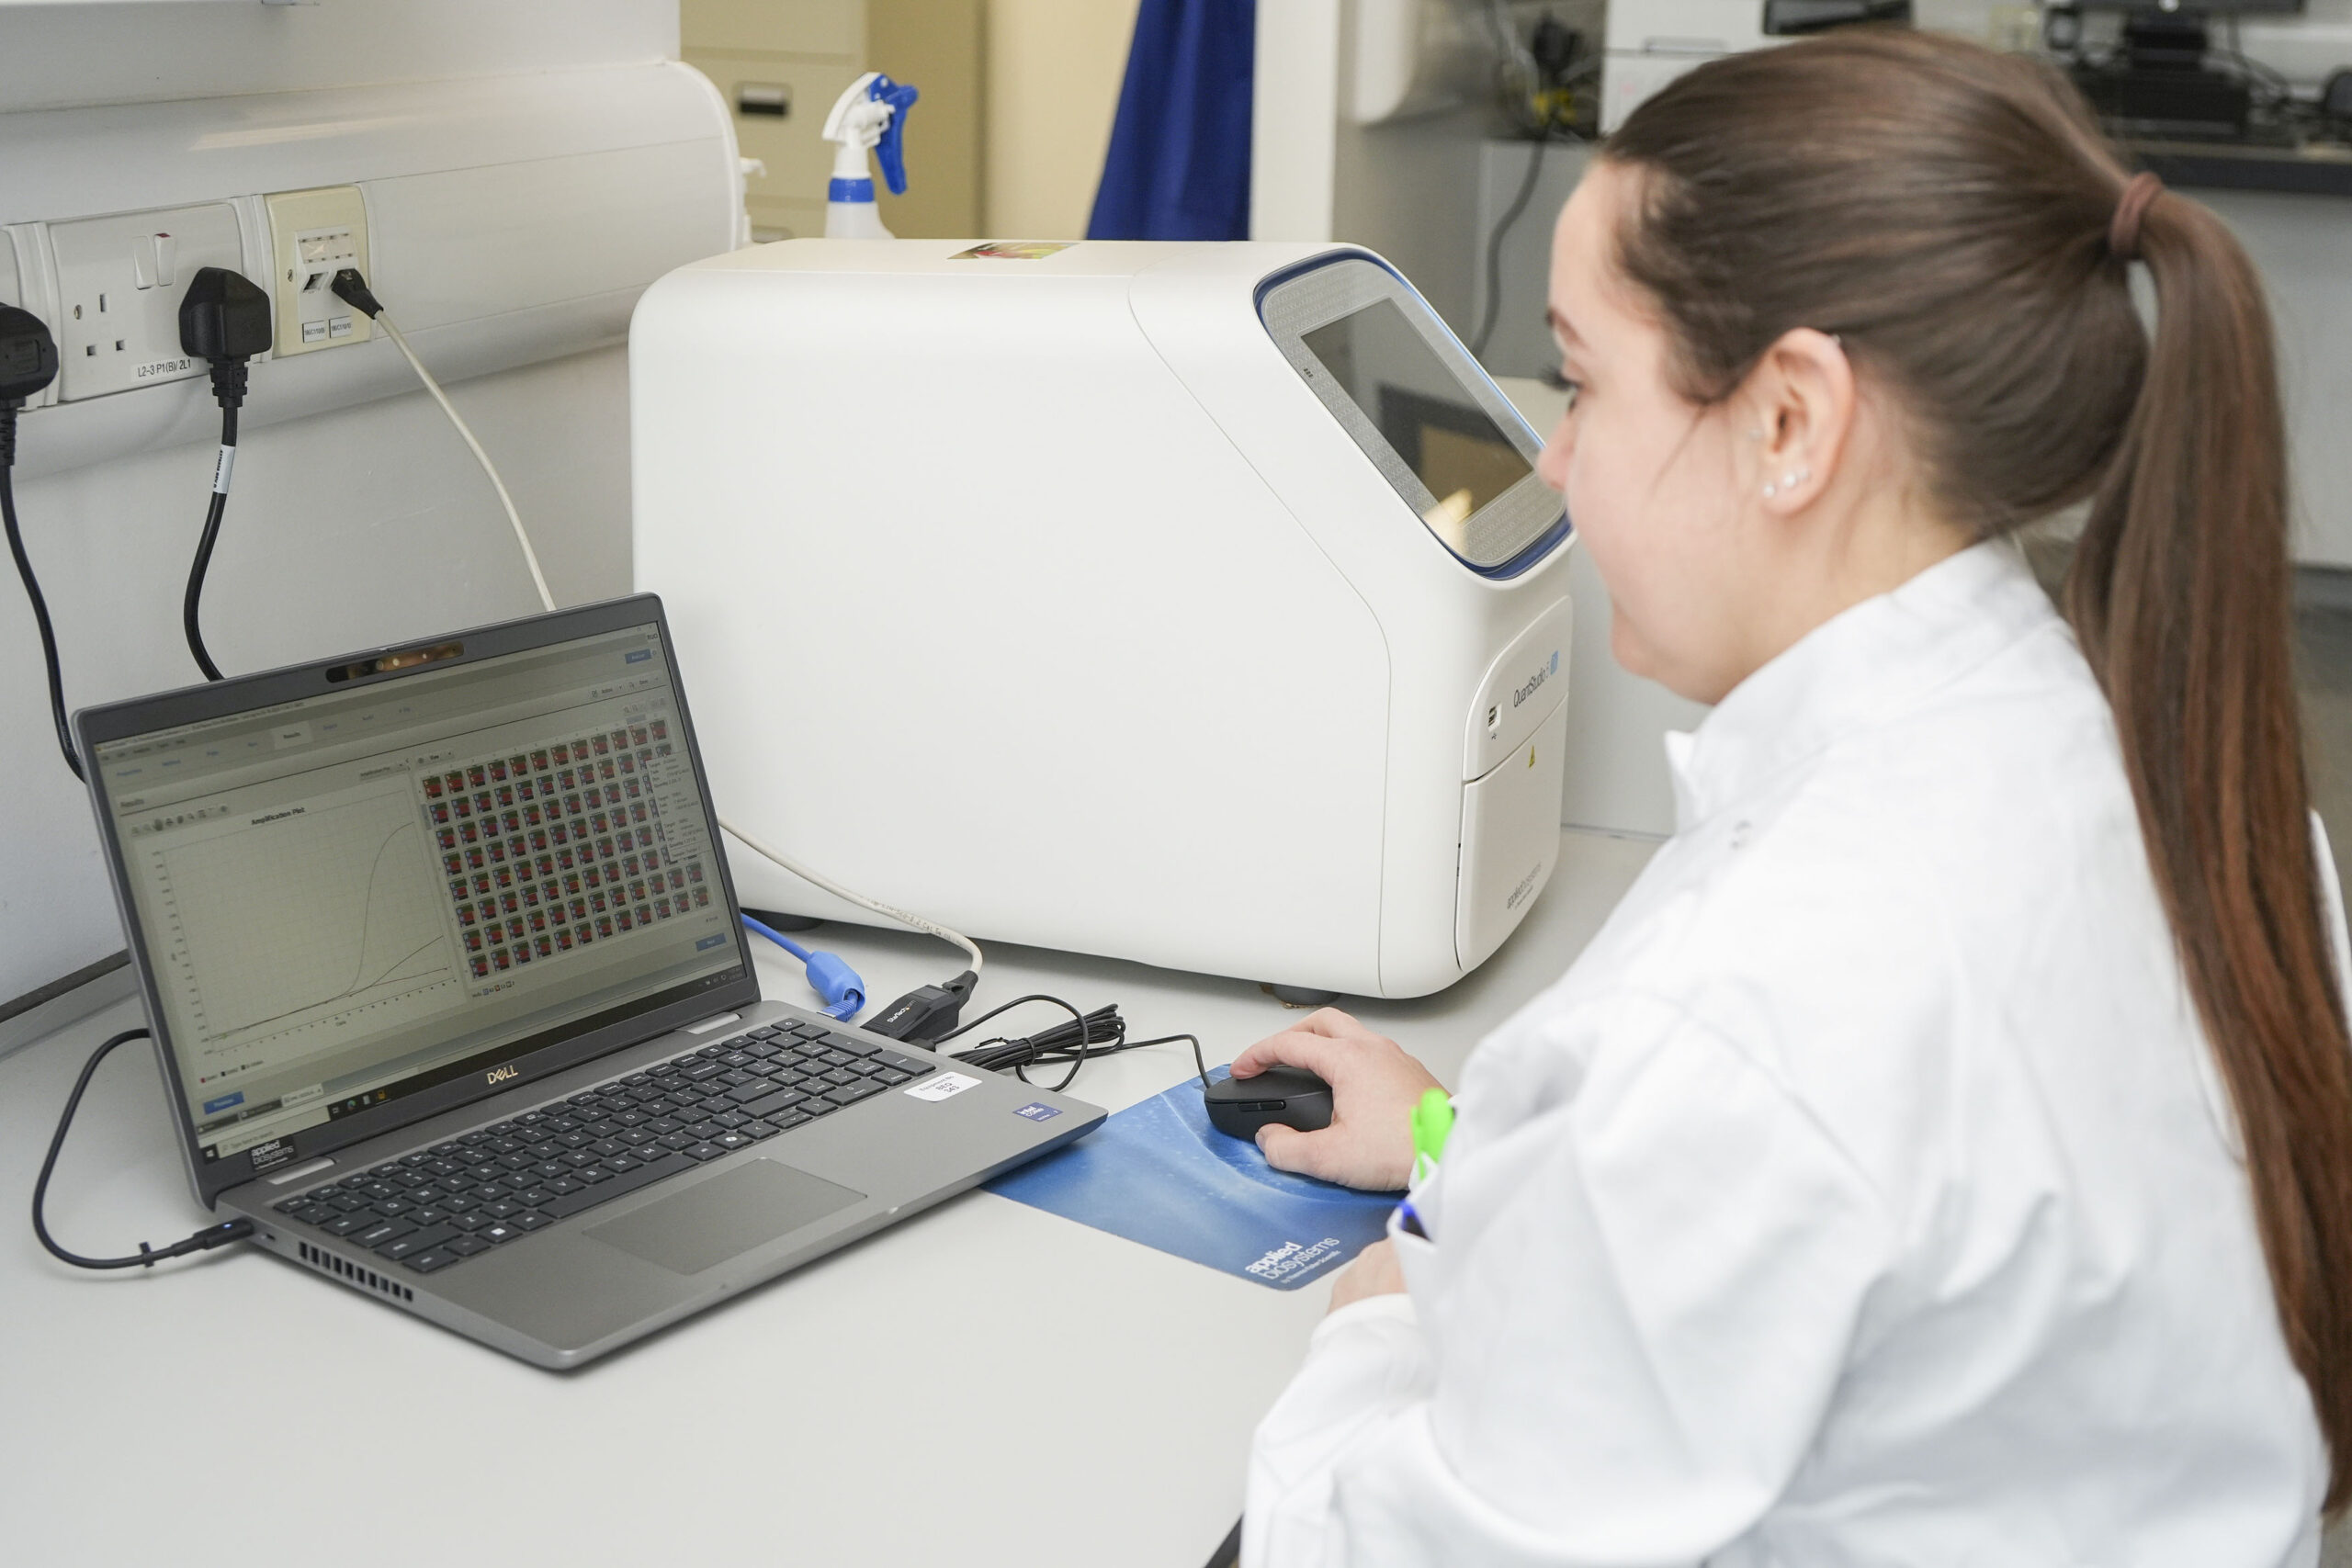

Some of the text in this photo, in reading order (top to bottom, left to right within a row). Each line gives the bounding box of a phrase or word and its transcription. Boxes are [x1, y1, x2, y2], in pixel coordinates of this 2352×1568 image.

[137, 365, 155, 378] L2-3
[179, 358, 191, 370] 2L1
[1513, 667, 1546, 708] QuantStudio
[252, 811, 291, 825] Amplification
[486, 1065, 519, 1085] DELL
[251, 1139, 280, 1156] applied
[253, 1145, 294, 1165] biosystems
[1245, 1241, 1303, 1274] applied
[1258, 1237, 1340, 1280] biosystems
